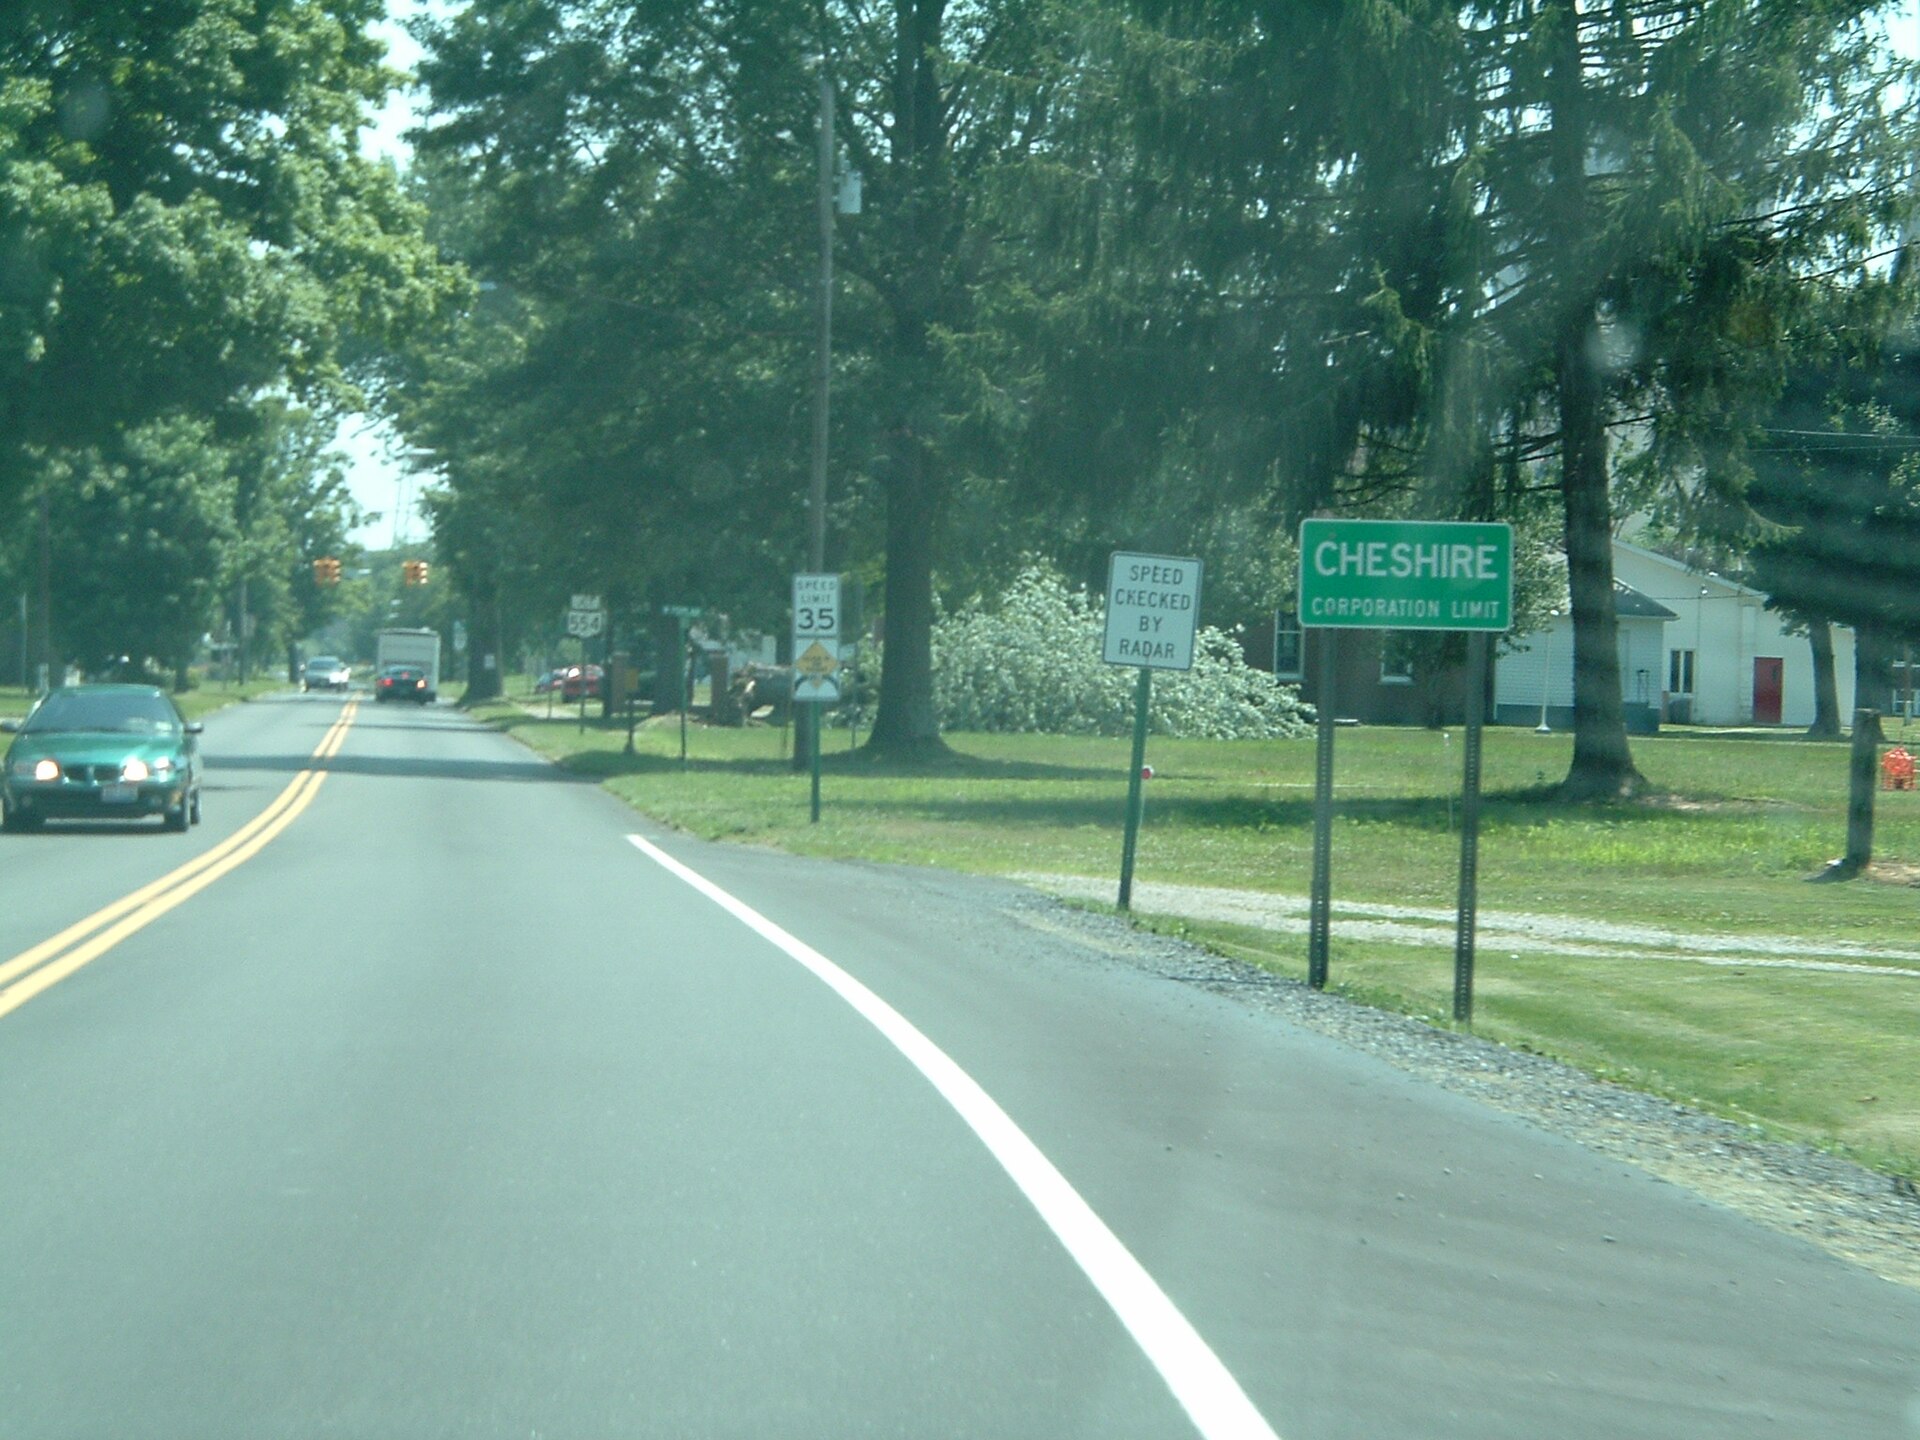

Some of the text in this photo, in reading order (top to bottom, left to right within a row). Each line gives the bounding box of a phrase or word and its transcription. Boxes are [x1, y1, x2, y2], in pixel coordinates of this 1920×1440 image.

[1314, 540, 1499, 580] CHESHIRE
[797, 579, 836, 591] SPEED
[1129, 565, 1184, 585] SPEED
[800, 593, 831, 604] LIMIT
[1115, 588, 1191, 611] CHECKED
[1311, 597, 1501, 619] CORPORATION LIMIT
[570, 614, 600, 632] 554
[797, 608, 835, 630] 35
[1139, 615, 1163, 633] BY
[1119, 638, 1176, 659] RADAR
